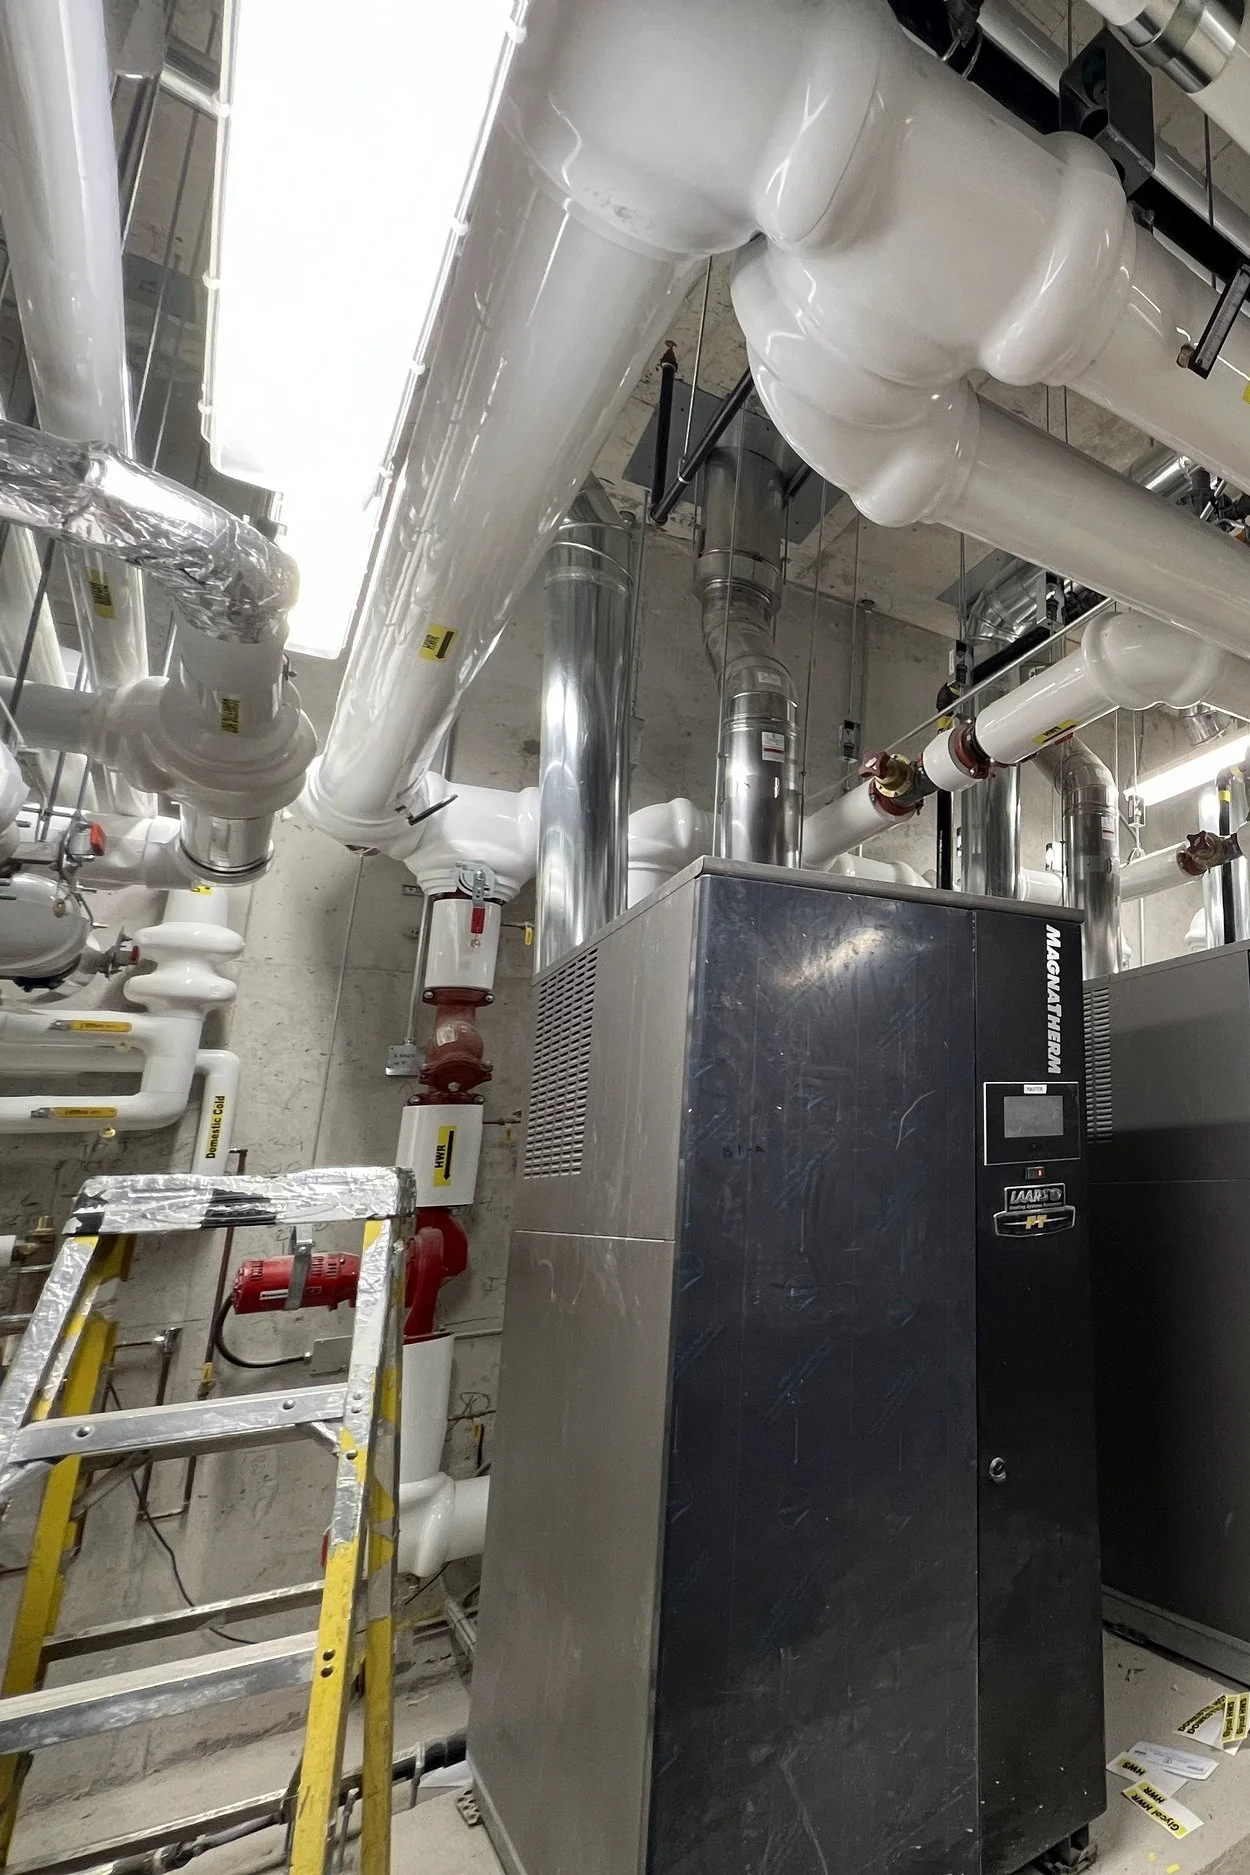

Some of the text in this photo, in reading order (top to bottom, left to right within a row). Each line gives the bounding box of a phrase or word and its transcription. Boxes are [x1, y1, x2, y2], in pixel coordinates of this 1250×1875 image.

[1046, 924, 1062, 1074] MAGNATHERM
[206, 1095, 225, 1158] Domestic Cold
[435, 1145, 446, 1168] HWR
[1010, 1189, 1051, 1204] LAARS
[1122, 1761, 1146, 1777] HWS
[1143, 1786, 1165, 1804] HWR
[1131, 1793, 1180, 1832] Glycol HWR
